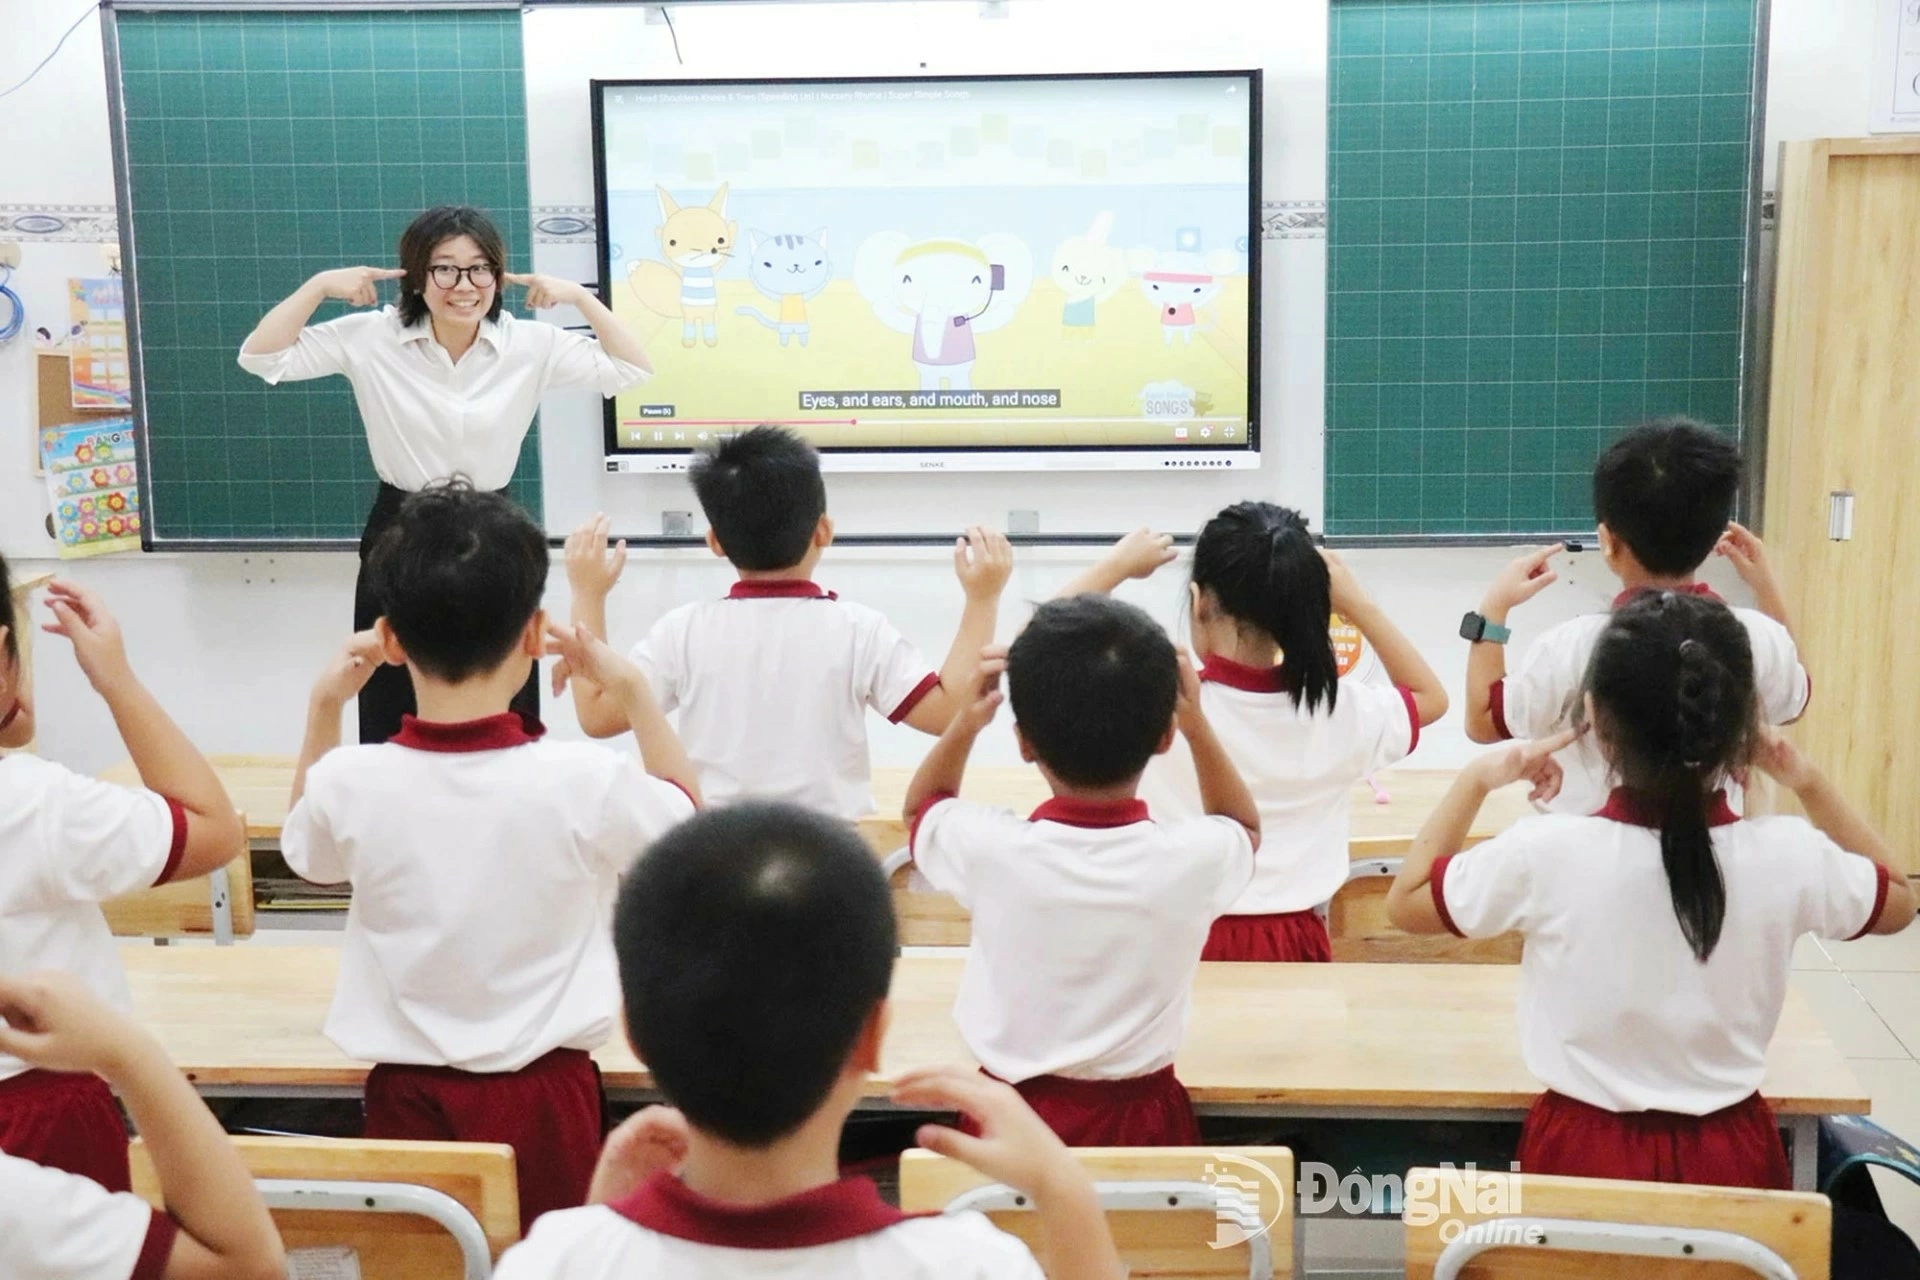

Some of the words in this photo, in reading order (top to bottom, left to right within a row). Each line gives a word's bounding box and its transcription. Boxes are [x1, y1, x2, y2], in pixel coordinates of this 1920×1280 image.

[803, 393, 839, 410] Eyes,
[843, 393, 868, 408] and
[872, 394, 906, 409] ears,
[910, 392, 936, 407] and
[940, 392, 988, 408] mouth,
[992, 392, 1019, 406] and
[1022, 394, 1057, 406] nose
[1146, 400, 1188, 415] SONGS
